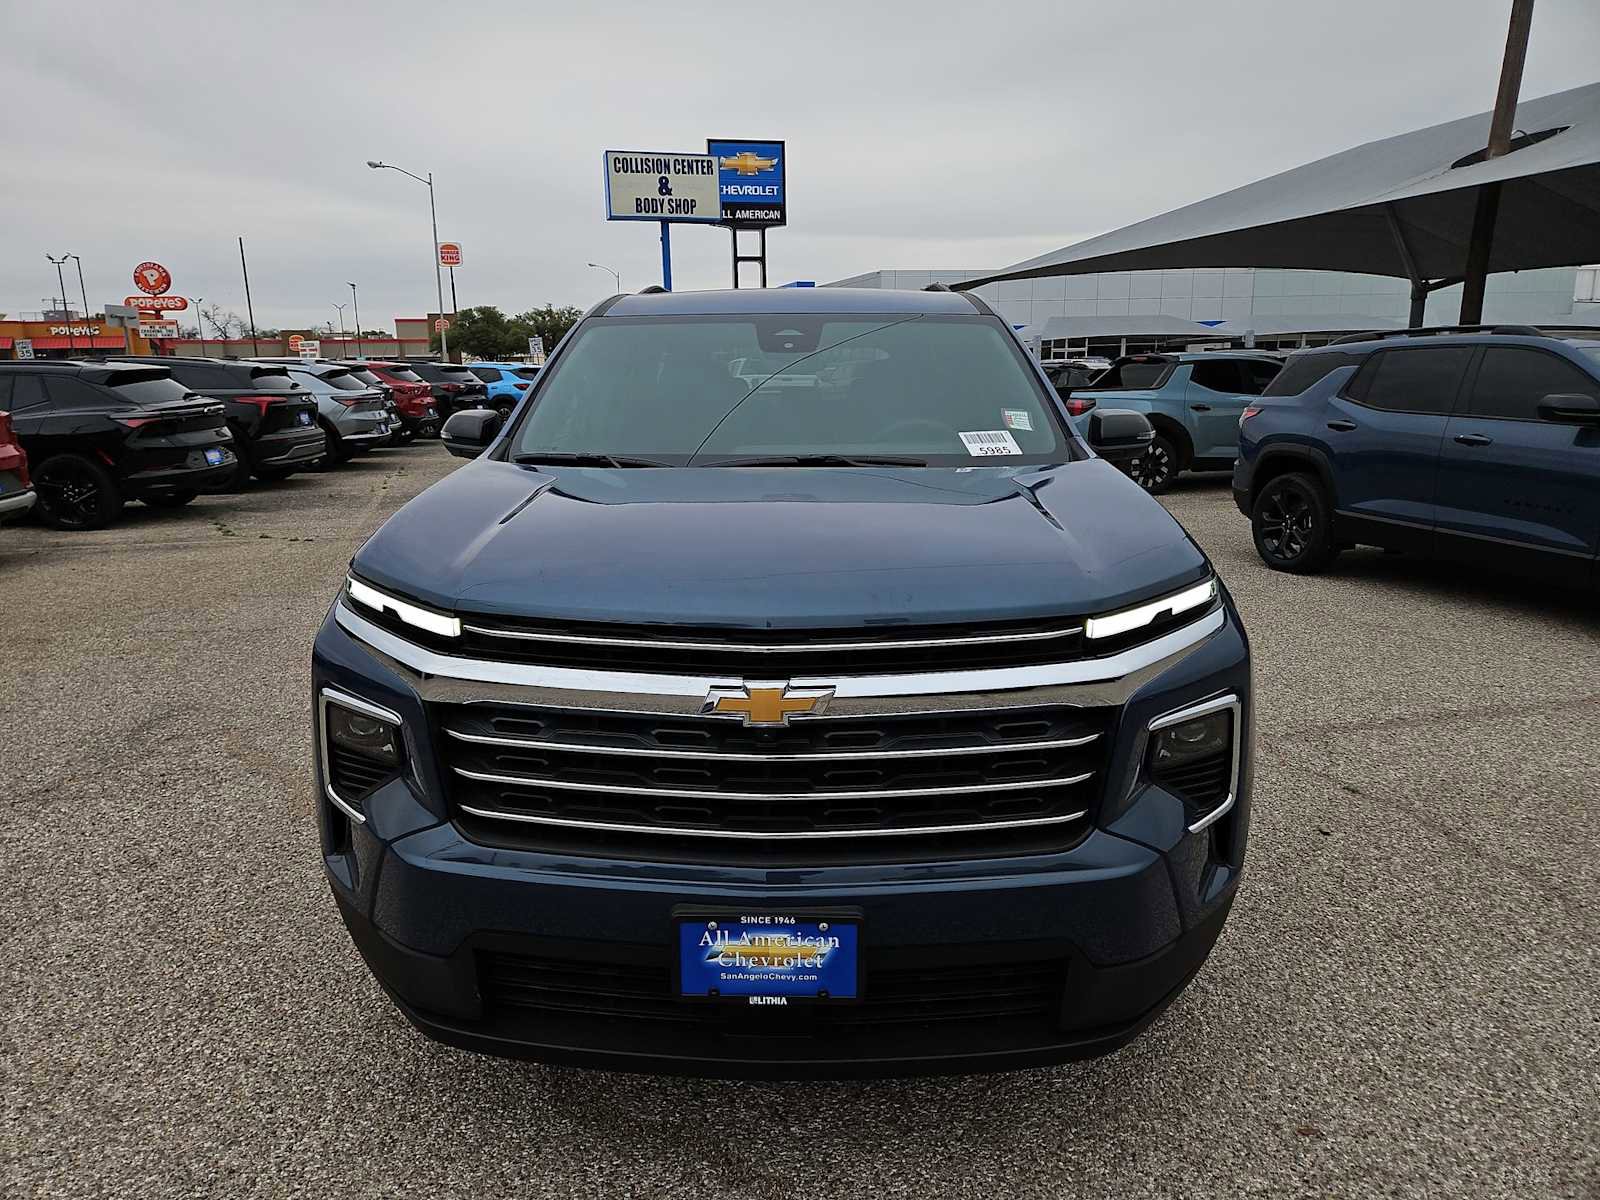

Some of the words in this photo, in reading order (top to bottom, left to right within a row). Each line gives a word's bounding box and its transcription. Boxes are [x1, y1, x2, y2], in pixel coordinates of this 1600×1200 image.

[613, 157, 671, 175] COLLISION
[673, 158, 714, 176] CENTER
[657, 175, 673, 197] &
[635, 197, 664, 214] BODY
[667, 198, 697, 215] SHOP
[722, 209, 733, 219] LL
[735, 210, 781, 220] AMERICAN
[19, 349, 32, 357] 35
[979, 446, 1011, 455] 5985
[740, 916, 771, 924] SINCE
[774, 916, 796, 924] 1946
[699, 930, 729, 946] All
[738, 931, 840, 948] American
[718, 951, 823, 969] Chevrolet
[720, 972, 818, 982] SanAngeloChevy.com
[757, 996, 788, 1005] LITHIA
